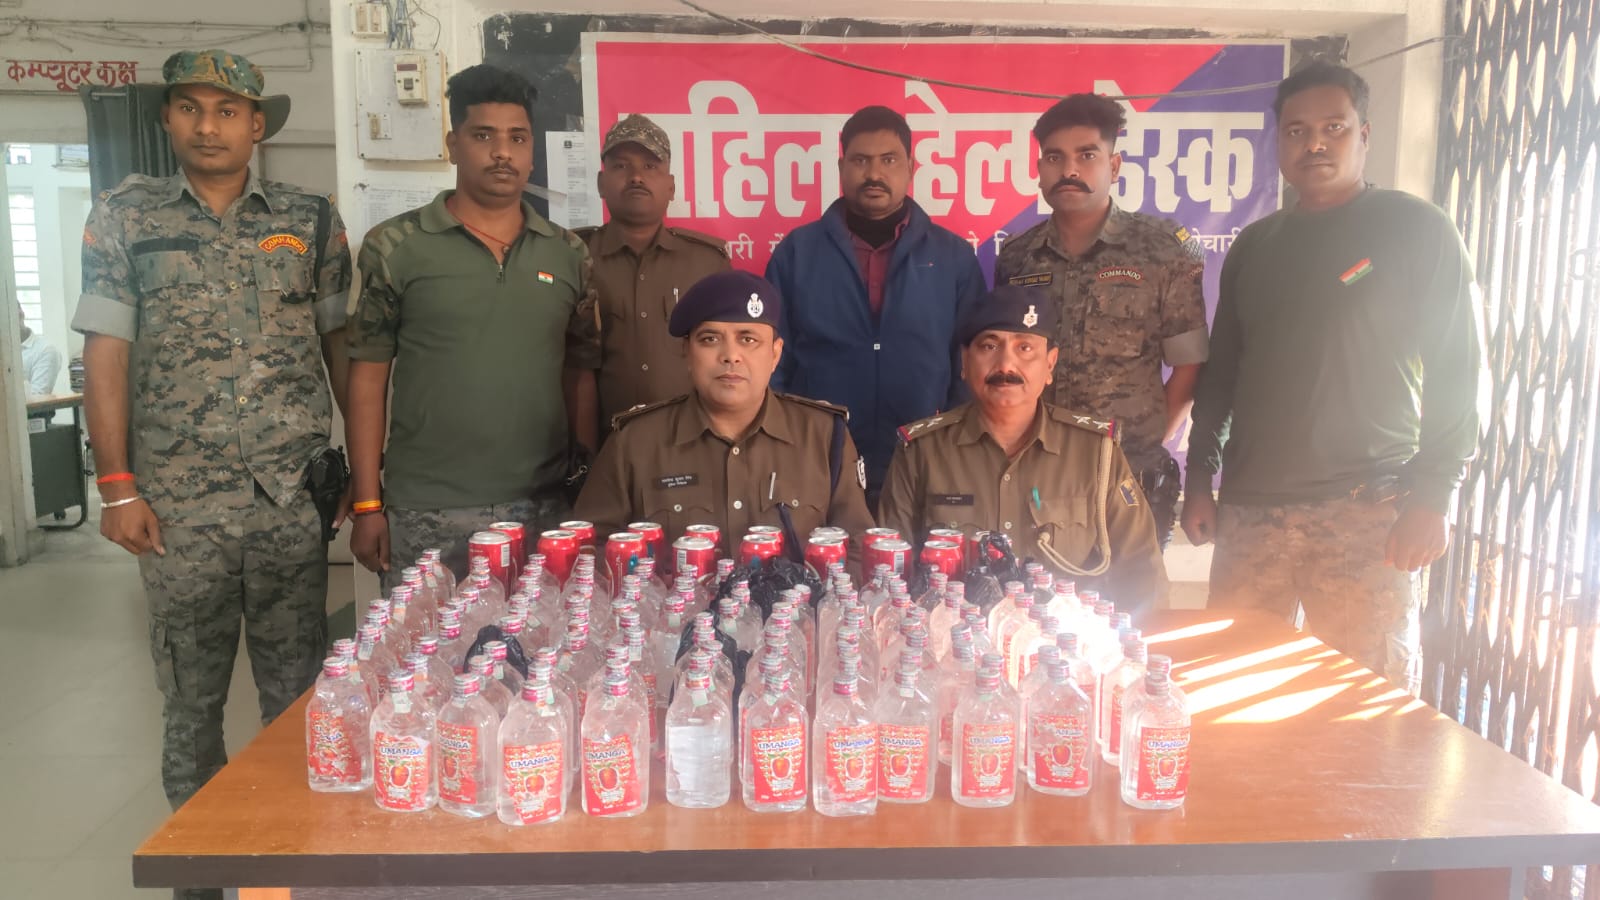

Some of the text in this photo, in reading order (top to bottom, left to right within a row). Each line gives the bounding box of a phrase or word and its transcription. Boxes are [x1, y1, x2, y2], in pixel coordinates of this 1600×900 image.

[97, 61, 139, 88] कक्ष
[1099, 270, 1141, 281] COMMANDO
[758, 738, 800, 749] UMANGA
[834, 739, 874, 748] UMANGA
[881, 738, 922, 747] UMANGA
[1148, 740, 1187, 749] UMANGA
[381, 746, 424, 756] UMANGA
[510, 756, 556, 769] UMANGA
